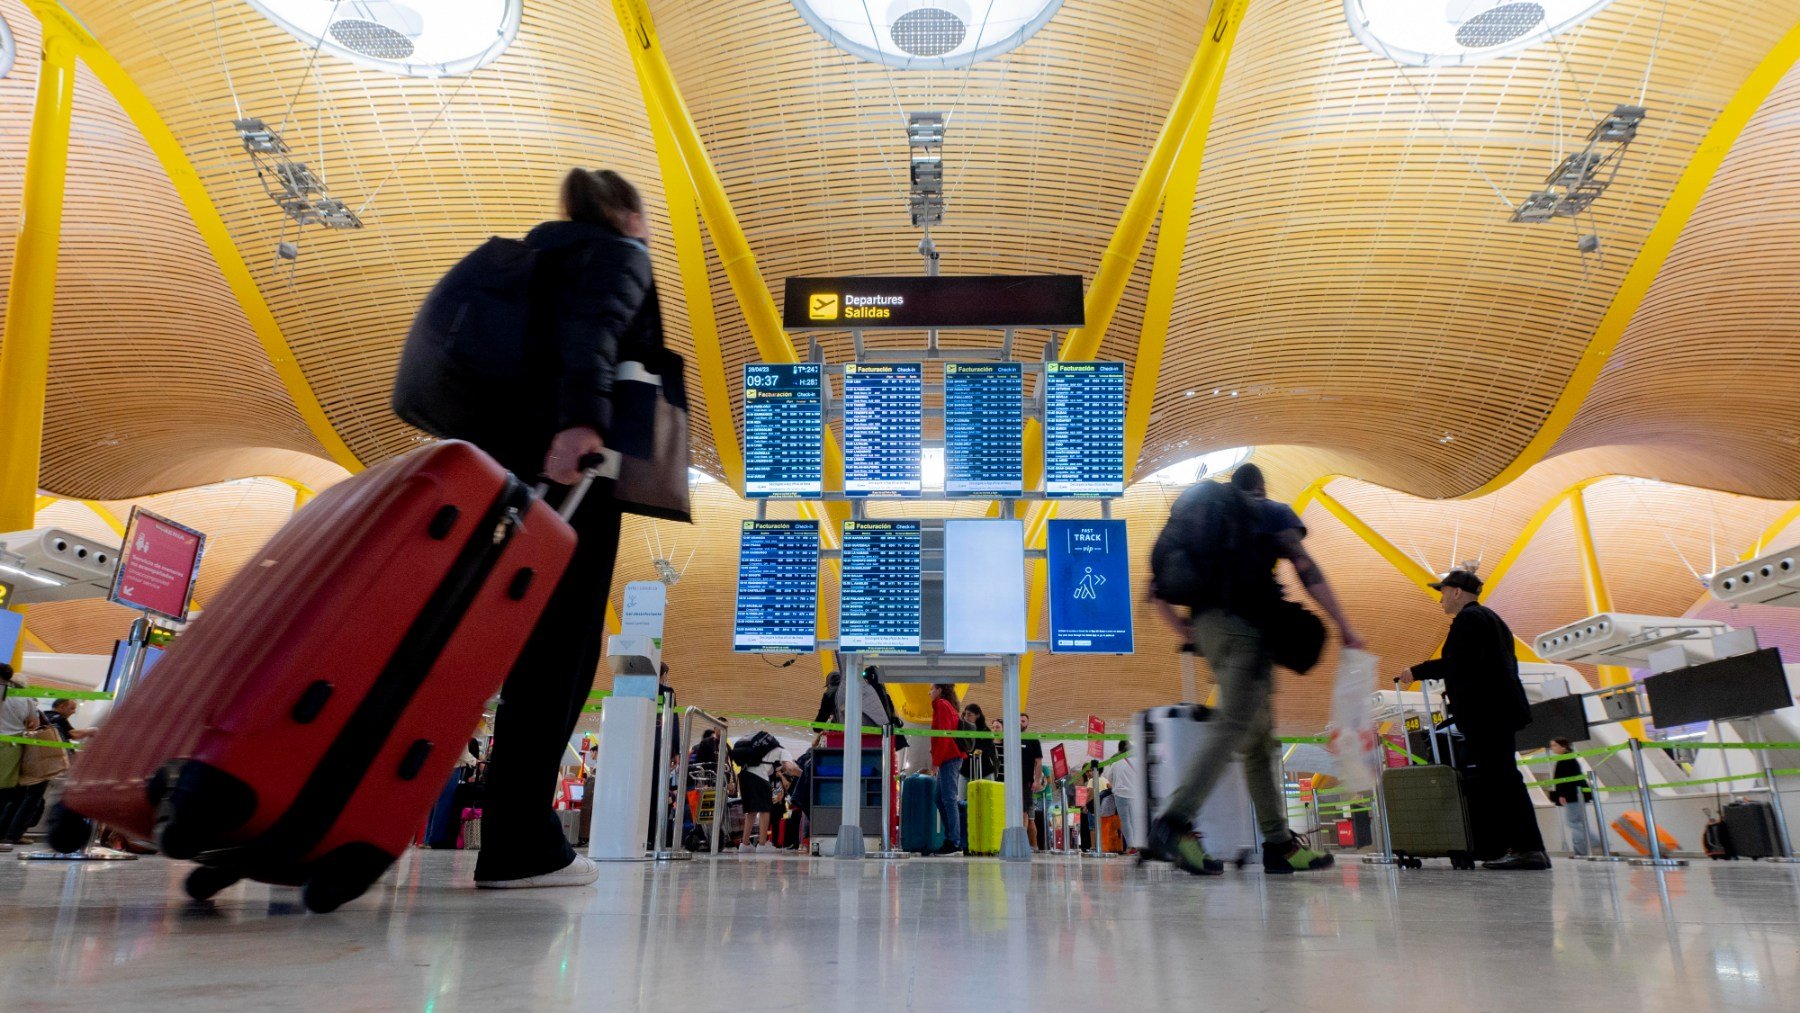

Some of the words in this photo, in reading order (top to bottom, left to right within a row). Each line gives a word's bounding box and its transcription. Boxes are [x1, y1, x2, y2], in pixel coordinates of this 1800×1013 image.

[845, 295, 904, 306] Departures
[844, 306, 890, 318] Salidas
[746, 375, 779, 387] 09:37
[1073, 533, 1102, 541] TRACK
[1082, 544, 1094, 554] vip
